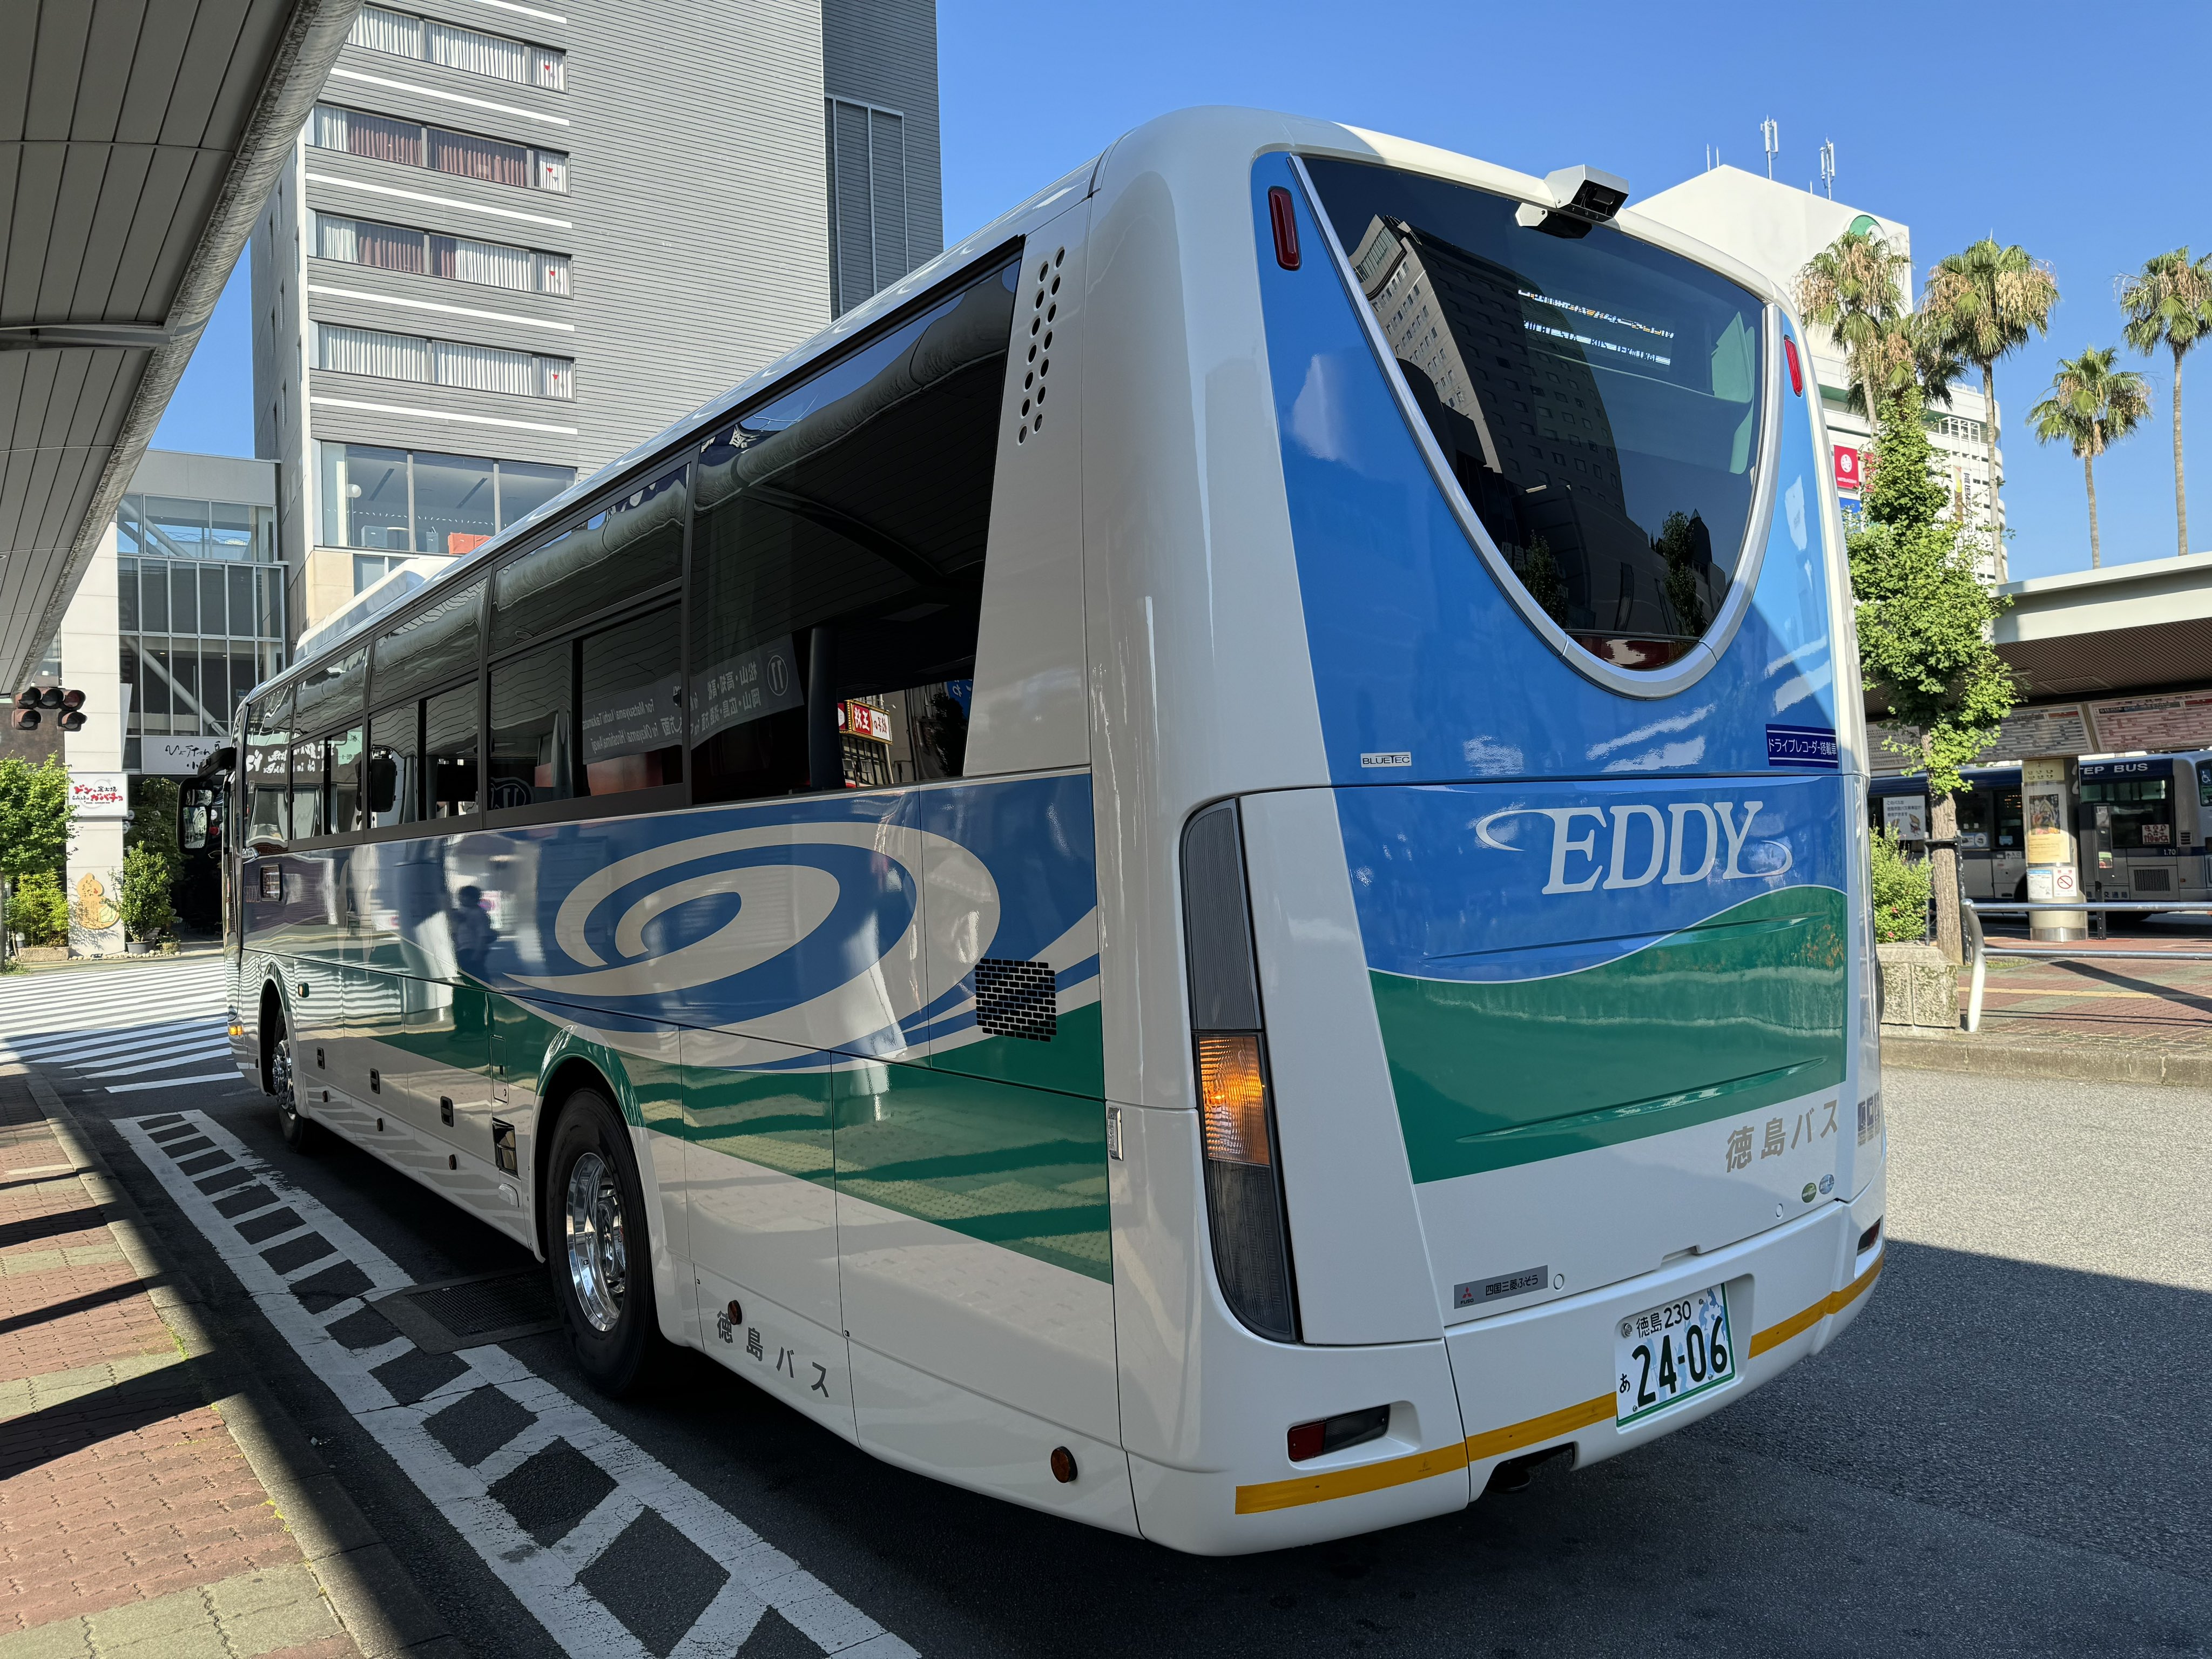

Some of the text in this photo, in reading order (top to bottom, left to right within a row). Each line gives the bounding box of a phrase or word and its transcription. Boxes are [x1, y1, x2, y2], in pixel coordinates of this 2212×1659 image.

[1363, 755, 1410, 764] BLUETEC
[1769, 738, 1837, 756] ドライブレコーダー搭載車
[2114, 763, 2148, 773] BUS
[1476, 801, 1792, 894] EDDY
[1725, 1100, 1837, 1173] 徳島バス
[1486, 1275, 1538, 1296] 四国三菱ふそう
[1636, 1300, 1691, 1338] 徳島 230
[717, 1310, 829, 1398] 徳島バス
[1632, 1316, 1728, 1407] 24-06
[1620, 1373, 1630, 1393] あ
